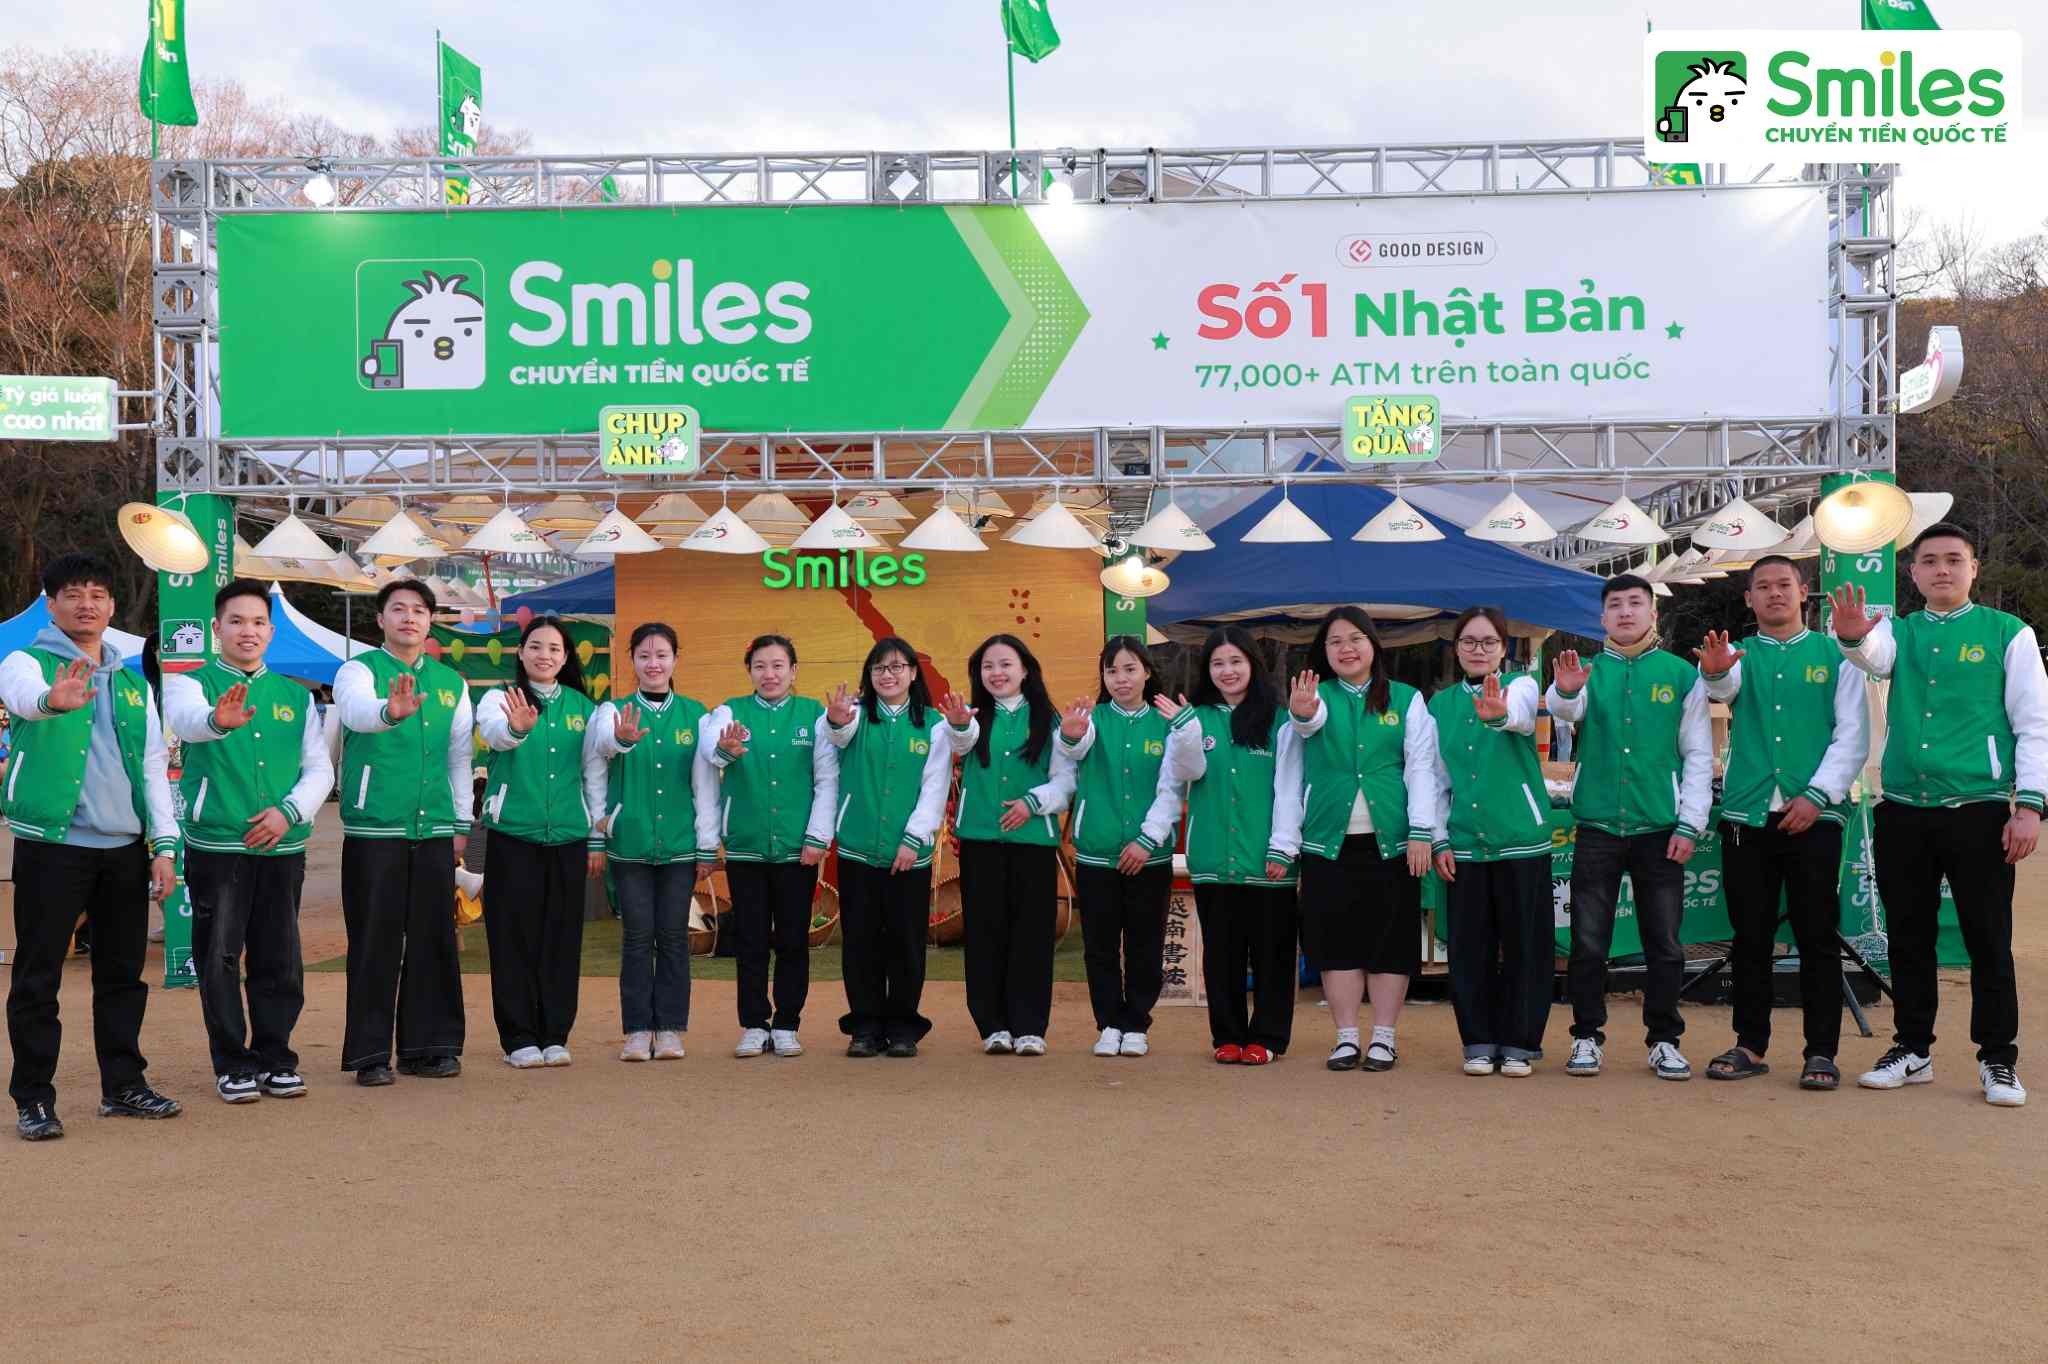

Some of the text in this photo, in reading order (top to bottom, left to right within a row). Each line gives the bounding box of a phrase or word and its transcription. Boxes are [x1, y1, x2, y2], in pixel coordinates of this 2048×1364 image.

[1378, 241, 1484, 258] GOOD DESIGN
[508, 258, 812, 347] Smiles
[1355, 287, 1505, 348] Nhật
[1525, 278, 1645, 333] Bản
[509, 357, 617, 385] CHUYỂN
[691, 356, 768, 386] QUỐC
[776, 355, 811, 383] TẾ
[1195, 352, 1650, 392] 77,000+ ATM trên toàn quốc
[4, 413, 46, 430] cao
[607, 411, 687, 440] CHỤP
[607, 438, 666, 466] ẢNH
[215, 518, 229, 588] Smiles
[763, 547, 927, 590] Smiles
